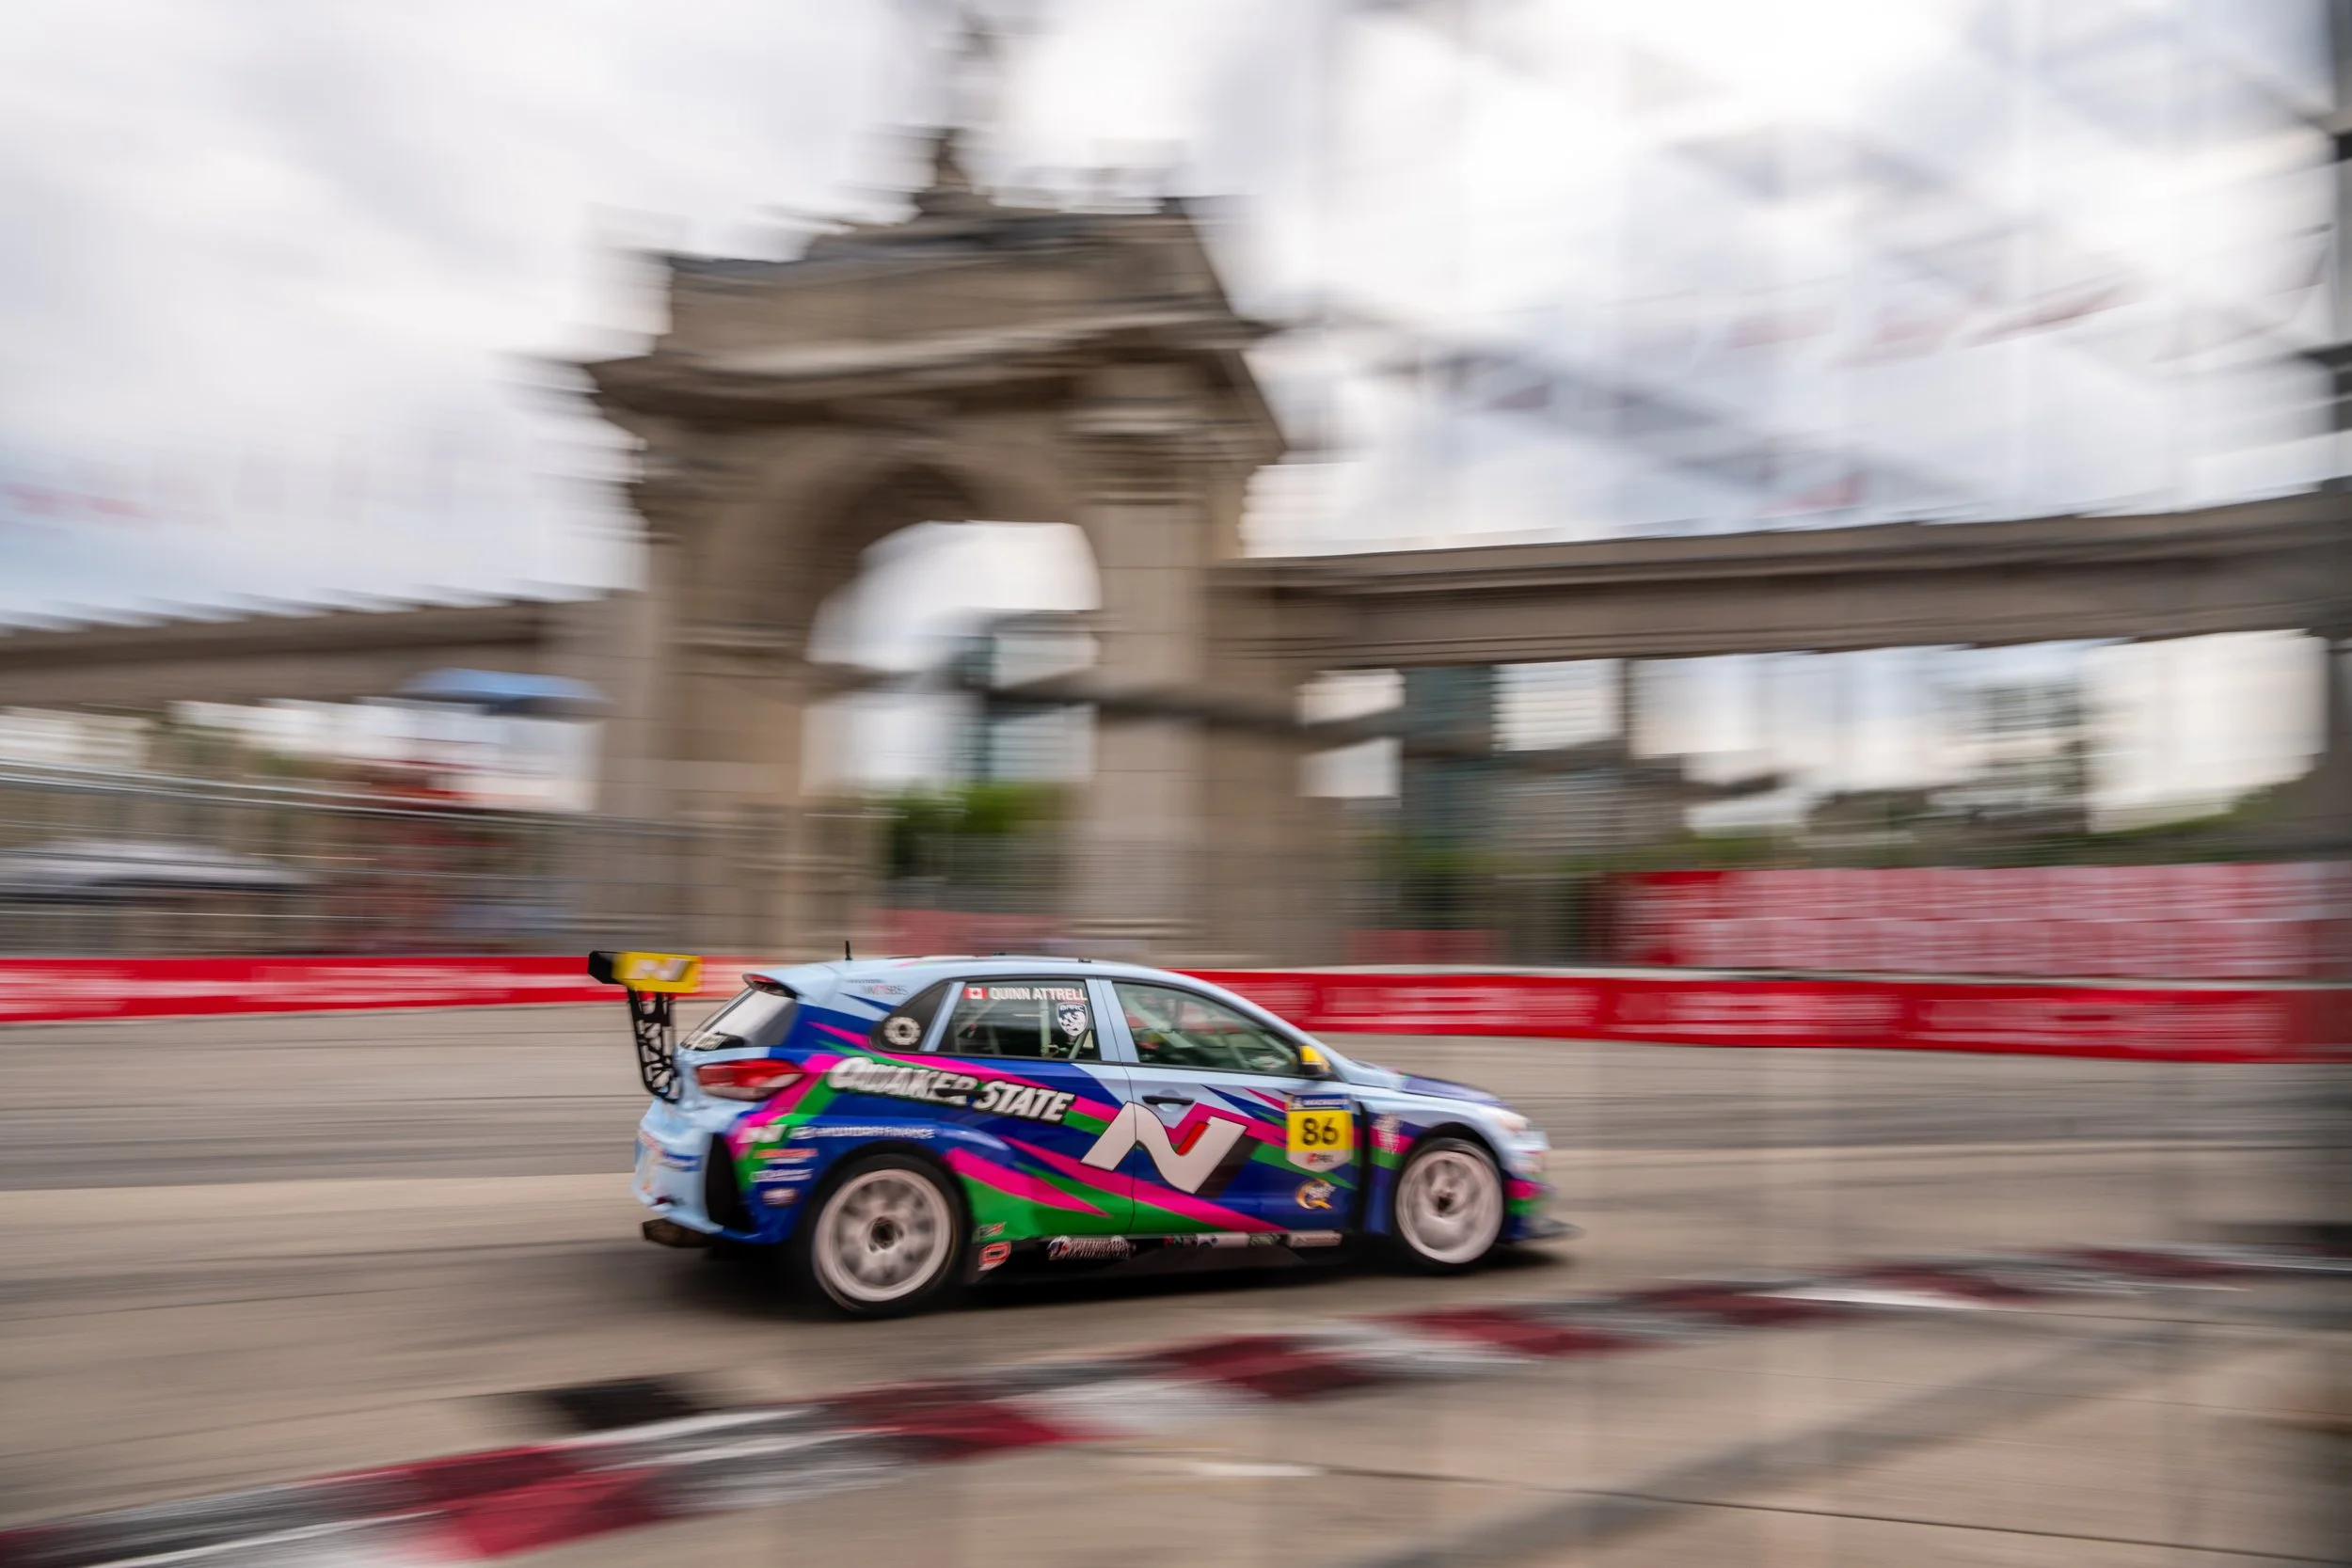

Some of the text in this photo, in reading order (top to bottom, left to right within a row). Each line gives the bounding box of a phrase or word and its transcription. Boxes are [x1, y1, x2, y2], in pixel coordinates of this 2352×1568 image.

[989, 987, 1089, 1001] QUINN ATTRELL
[829, 1056, 1074, 1121] QUAKER STATE
[1302, 1117, 1339, 1146] 86
